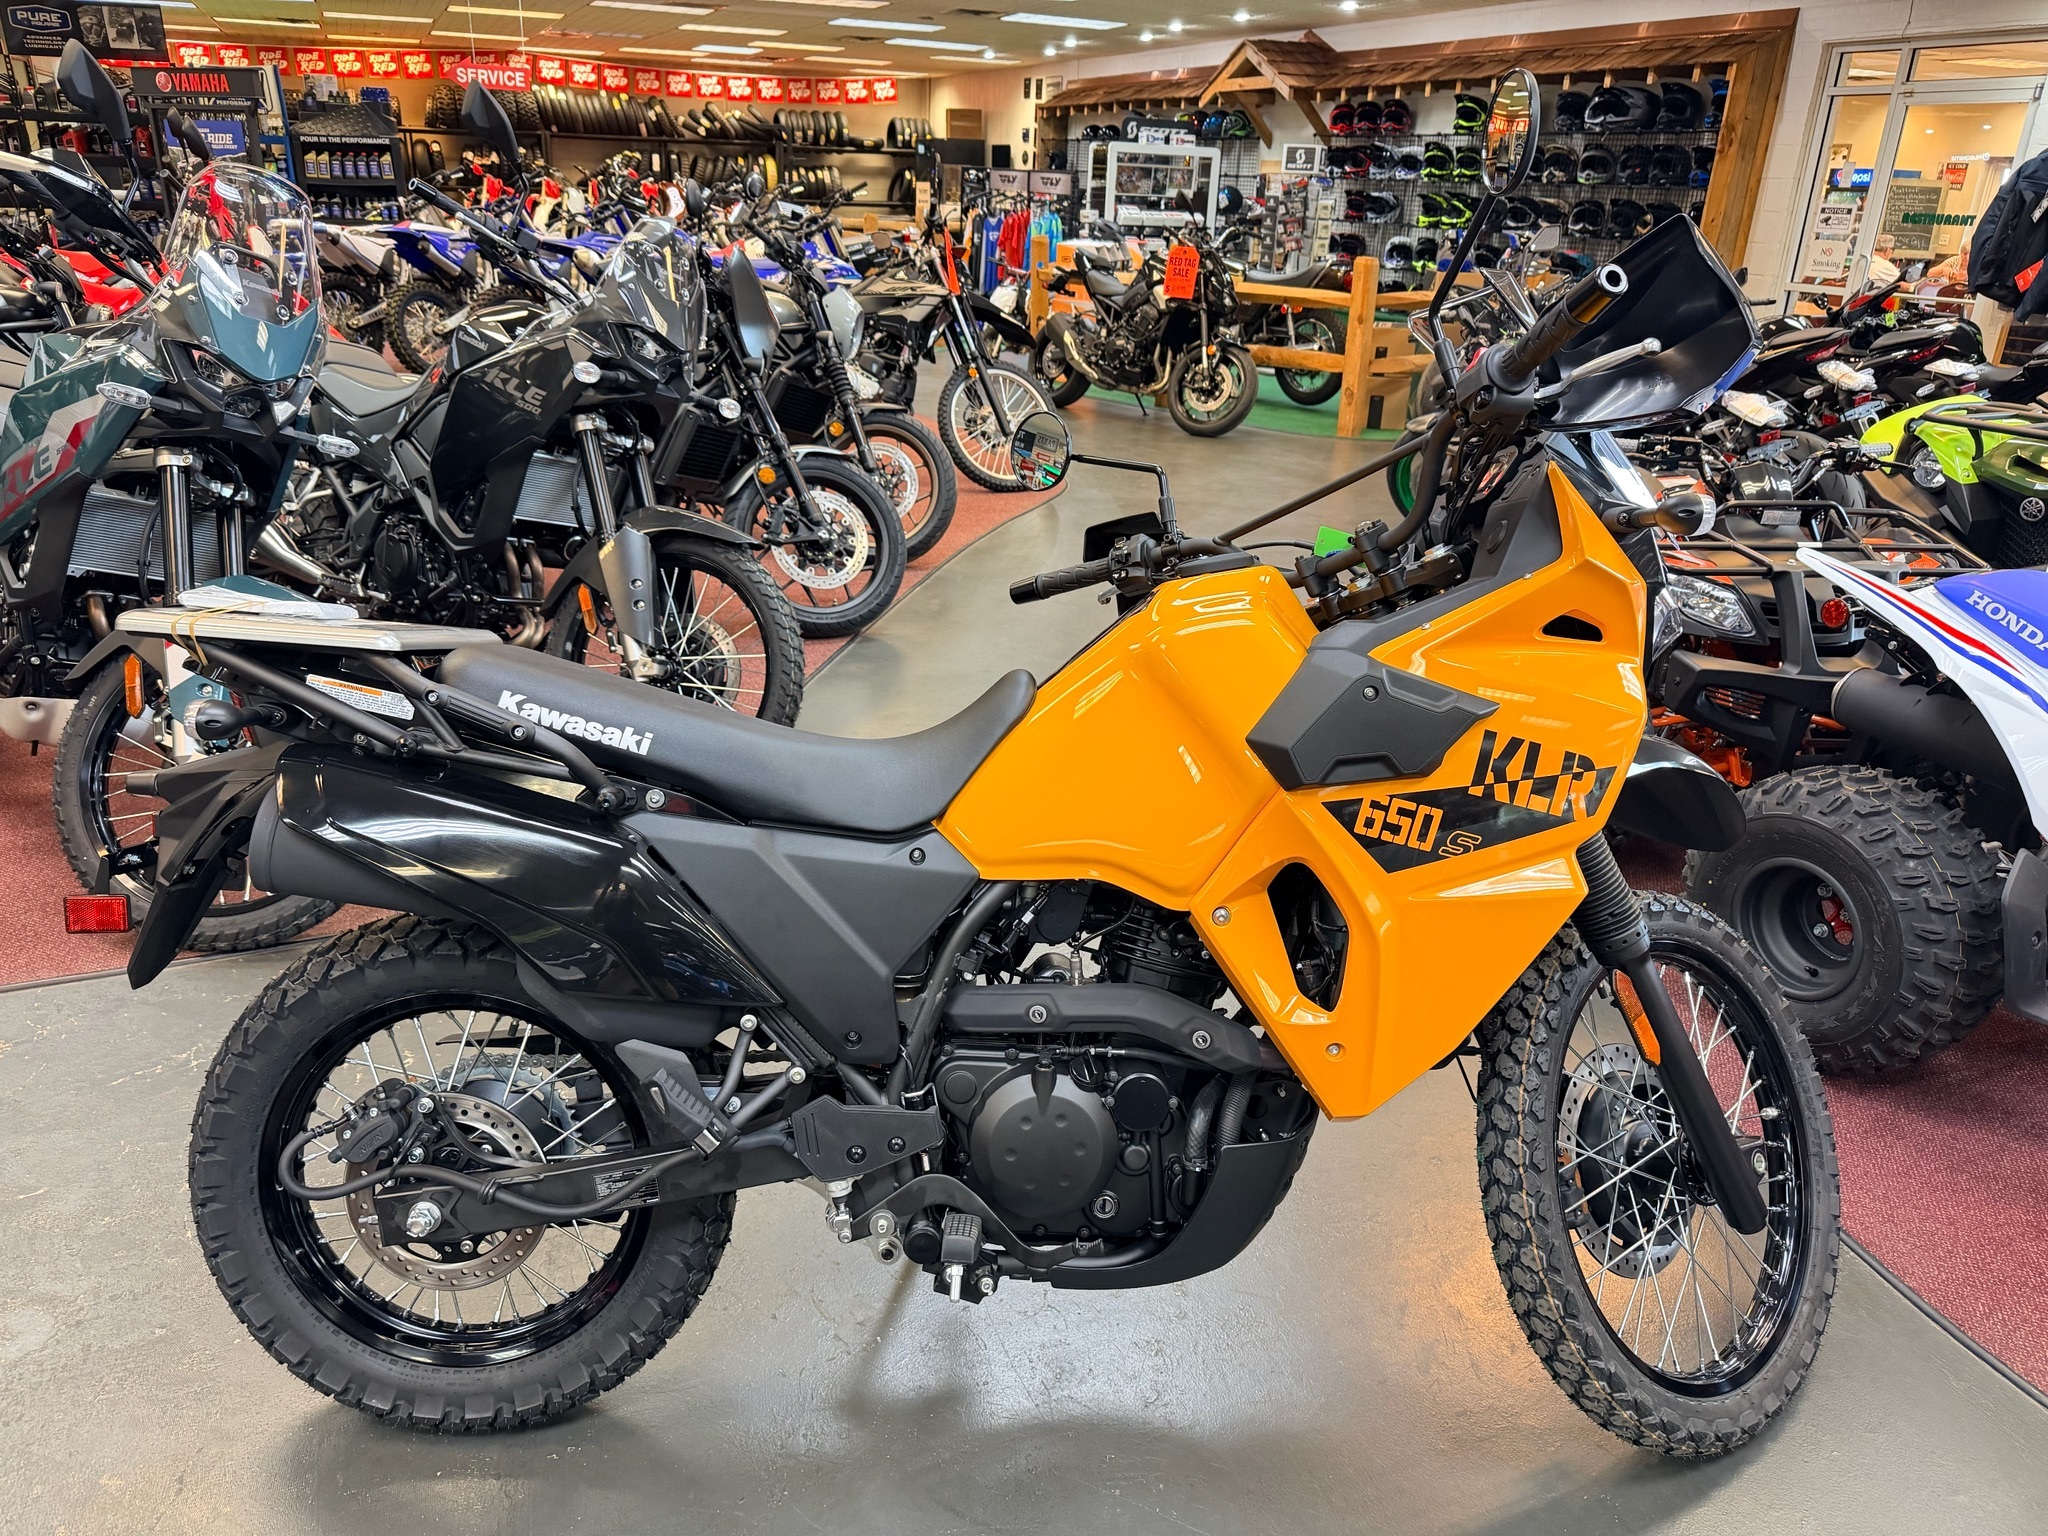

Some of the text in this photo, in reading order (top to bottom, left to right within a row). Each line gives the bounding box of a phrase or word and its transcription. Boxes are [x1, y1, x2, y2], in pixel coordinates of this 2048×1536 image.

[17, 10, 62, 22] PURE
[179, 47, 203, 56] RIDE
[219, 49, 243, 58] RIDE
[259, 51, 282, 60] RIDE
[297, 52, 319, 61] RIDE
[184, 56, 209, 66] RED
[224, 57, 249, 66] RED
[334, 52, 356, 62] RIDE
[369, 53, 391, 63] RIDE
[404, 54, 426, 64] RIDE
[440, 54, 461, 64] RIDE
[507, 54, 528, 63] RIDE
[263, 60, 288, 70] RED
[301, 61, 324, 72] RED
[337, 61, 361, 74] RED
[374, 62, 396, 75] RED
[408, 62, 431, 75] RED
[539, 60, 560, 69] RIDE
[572, 64, 593, 73] RIDE
[457, 68, 526, 87] SERVICE
[542, 69, 564, 80] RED
[604, 68, 624, 77] RIDE
[636, 72, 656, 80] RIDE
[171, 73, 230, 92] YAMAHA
[574, 73, 596, 84] RED
[606, 76, 628, 88] RED
[667, 74, 688, 82] RIDE
[698, 76, 718, 85] RIDE
[638, 79, 660, 91] RED
[669, 82, 691, 94] RED
[700, 84, 722, 96] RED
[1140, 126, 1188, 136] SCOTT
[208, 134, 233, 144] RIDE
[1852, 172, 1872, 182] epsi
[1170, 257, 1196, 267] RED TAG
[1812, 260, 1841, 269] Smoking
[1173, 268, 1189, 277] SALE
[458, 330, 489, 351] Kawasaki
[484, 366, 548, 406] KLE
[515, 400, 542, 415] 500
[339, 682, 363, 692] WARNING
[497, 690, 654, 756] Kawasaki
[1468, 730, 1598, 822] KLR
[1354, 795, 1482, 858] 650 S
